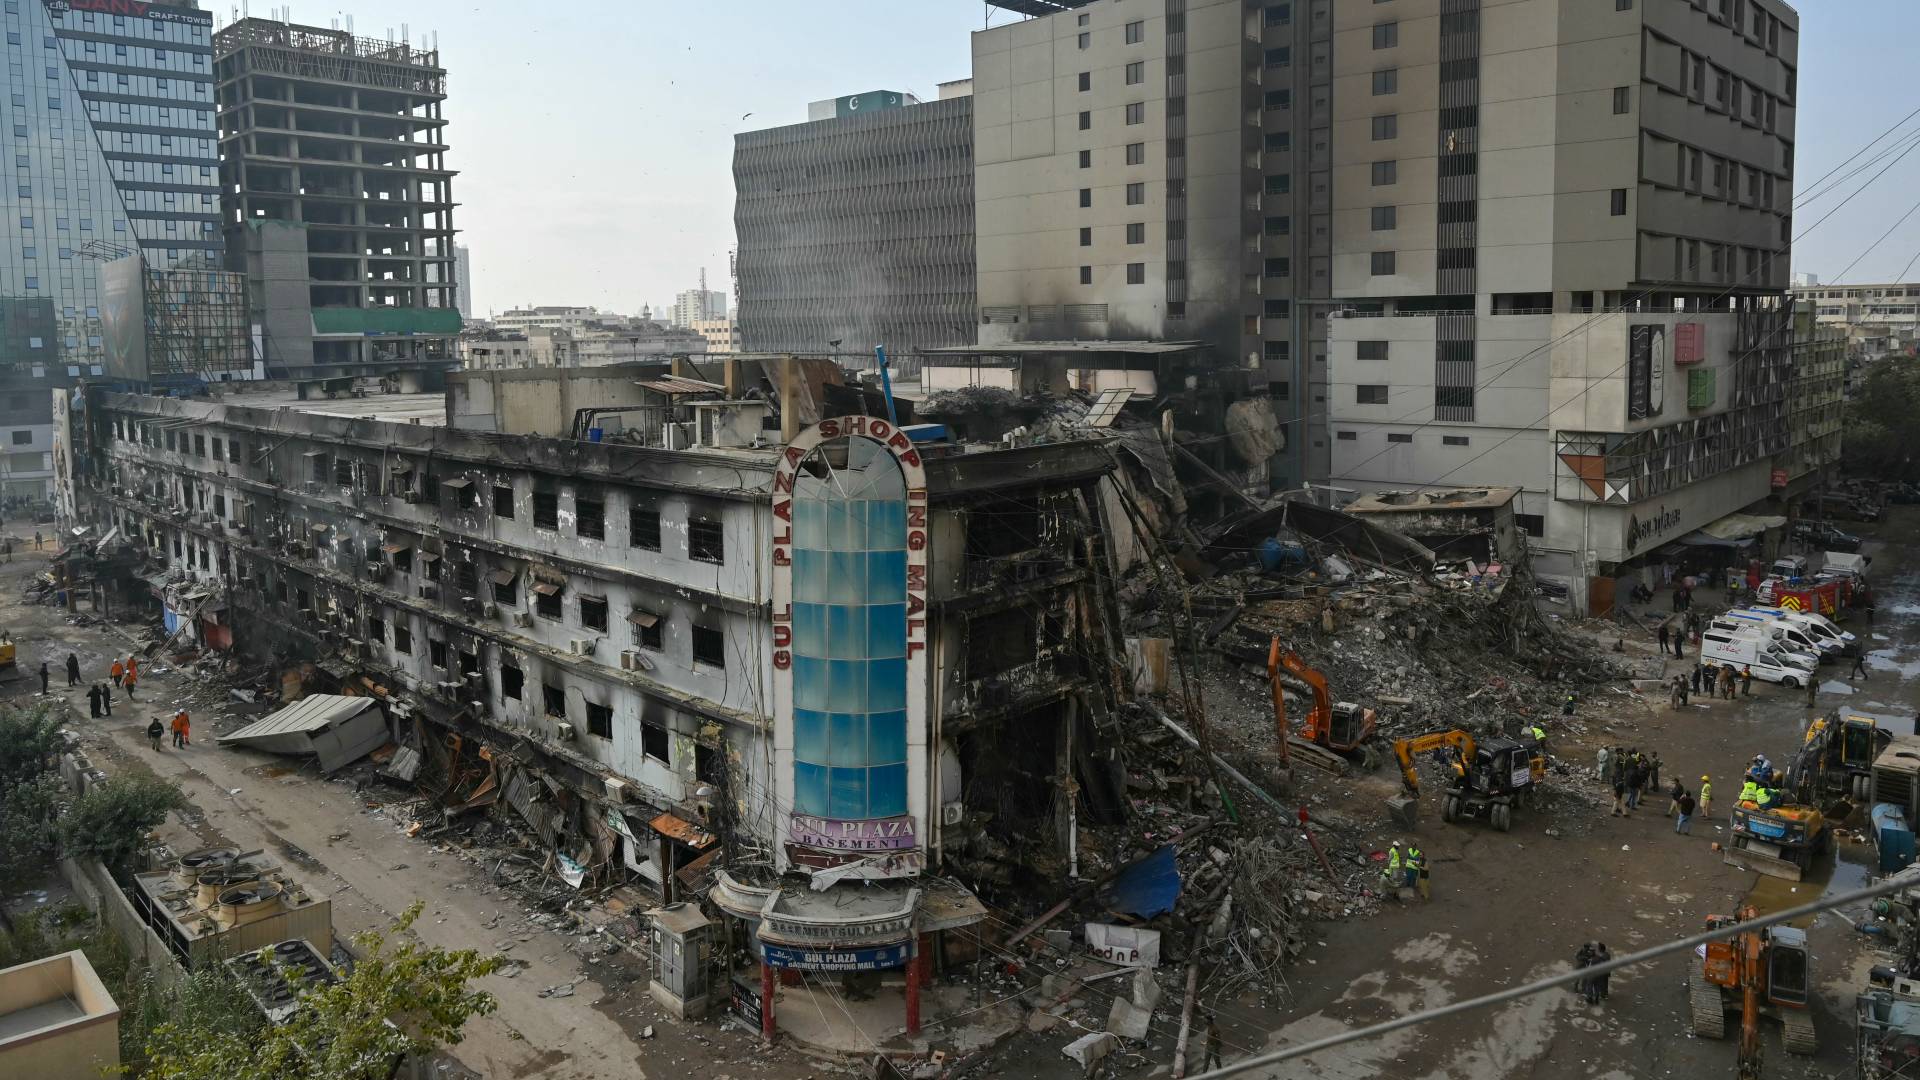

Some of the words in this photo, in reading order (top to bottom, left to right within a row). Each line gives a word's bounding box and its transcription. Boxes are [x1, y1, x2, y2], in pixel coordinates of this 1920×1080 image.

[149, 11, 179, 20] CRAFT
[181, 15, 212, 25] TOWER
[773, 446, 806, 567] PLAZA
[907, 564, 926, 661] MALL
[773, 603, 791, 670] GUL
[791, 816, 833, 837] GUL
[841, 819, 914, 839] PLAZA
[803, 834, 901, 850] BASEMENT
[805, 953, 824, 963] GUL
[825, 953, 857, 963] PLAZA
[857, 961, 875, 970] MALL
